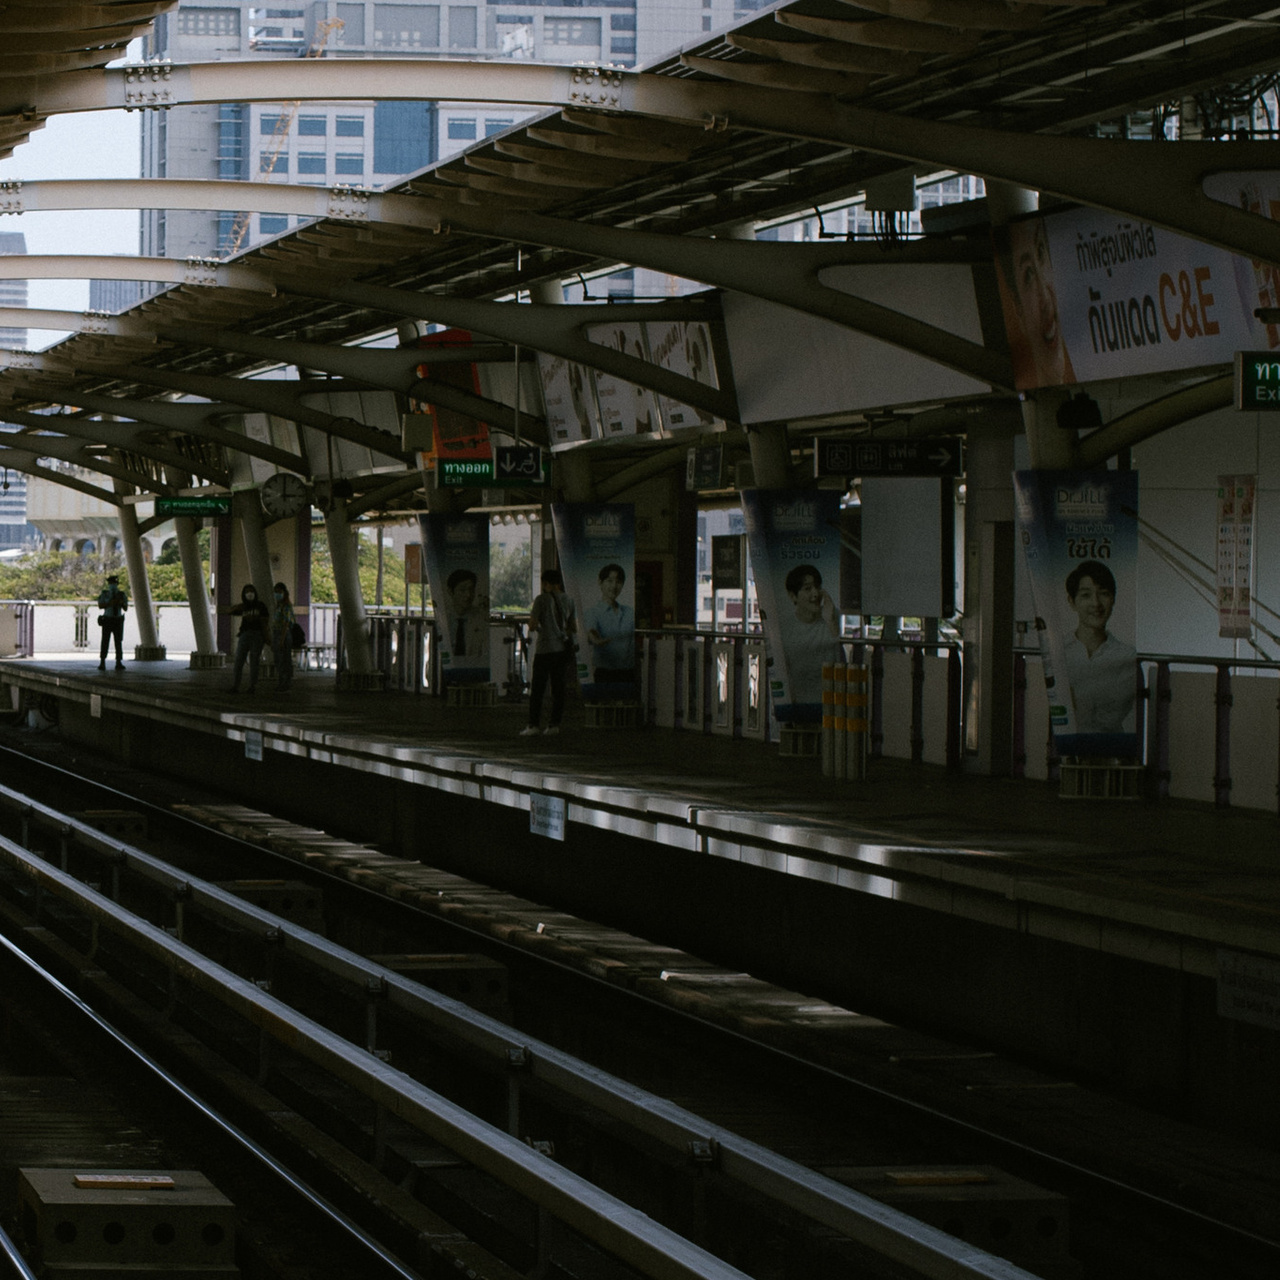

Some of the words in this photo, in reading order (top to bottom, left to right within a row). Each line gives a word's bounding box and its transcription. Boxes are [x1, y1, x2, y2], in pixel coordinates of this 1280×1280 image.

[1087, 286, 1161, 354] กันแดด
[1159, 265, 1220, 342] C&E
[444, 462, 490, 474] ทางออก
[445, 475, 463, 485] Exit
[1067, 537, 1112, 559] ใช้ได้
